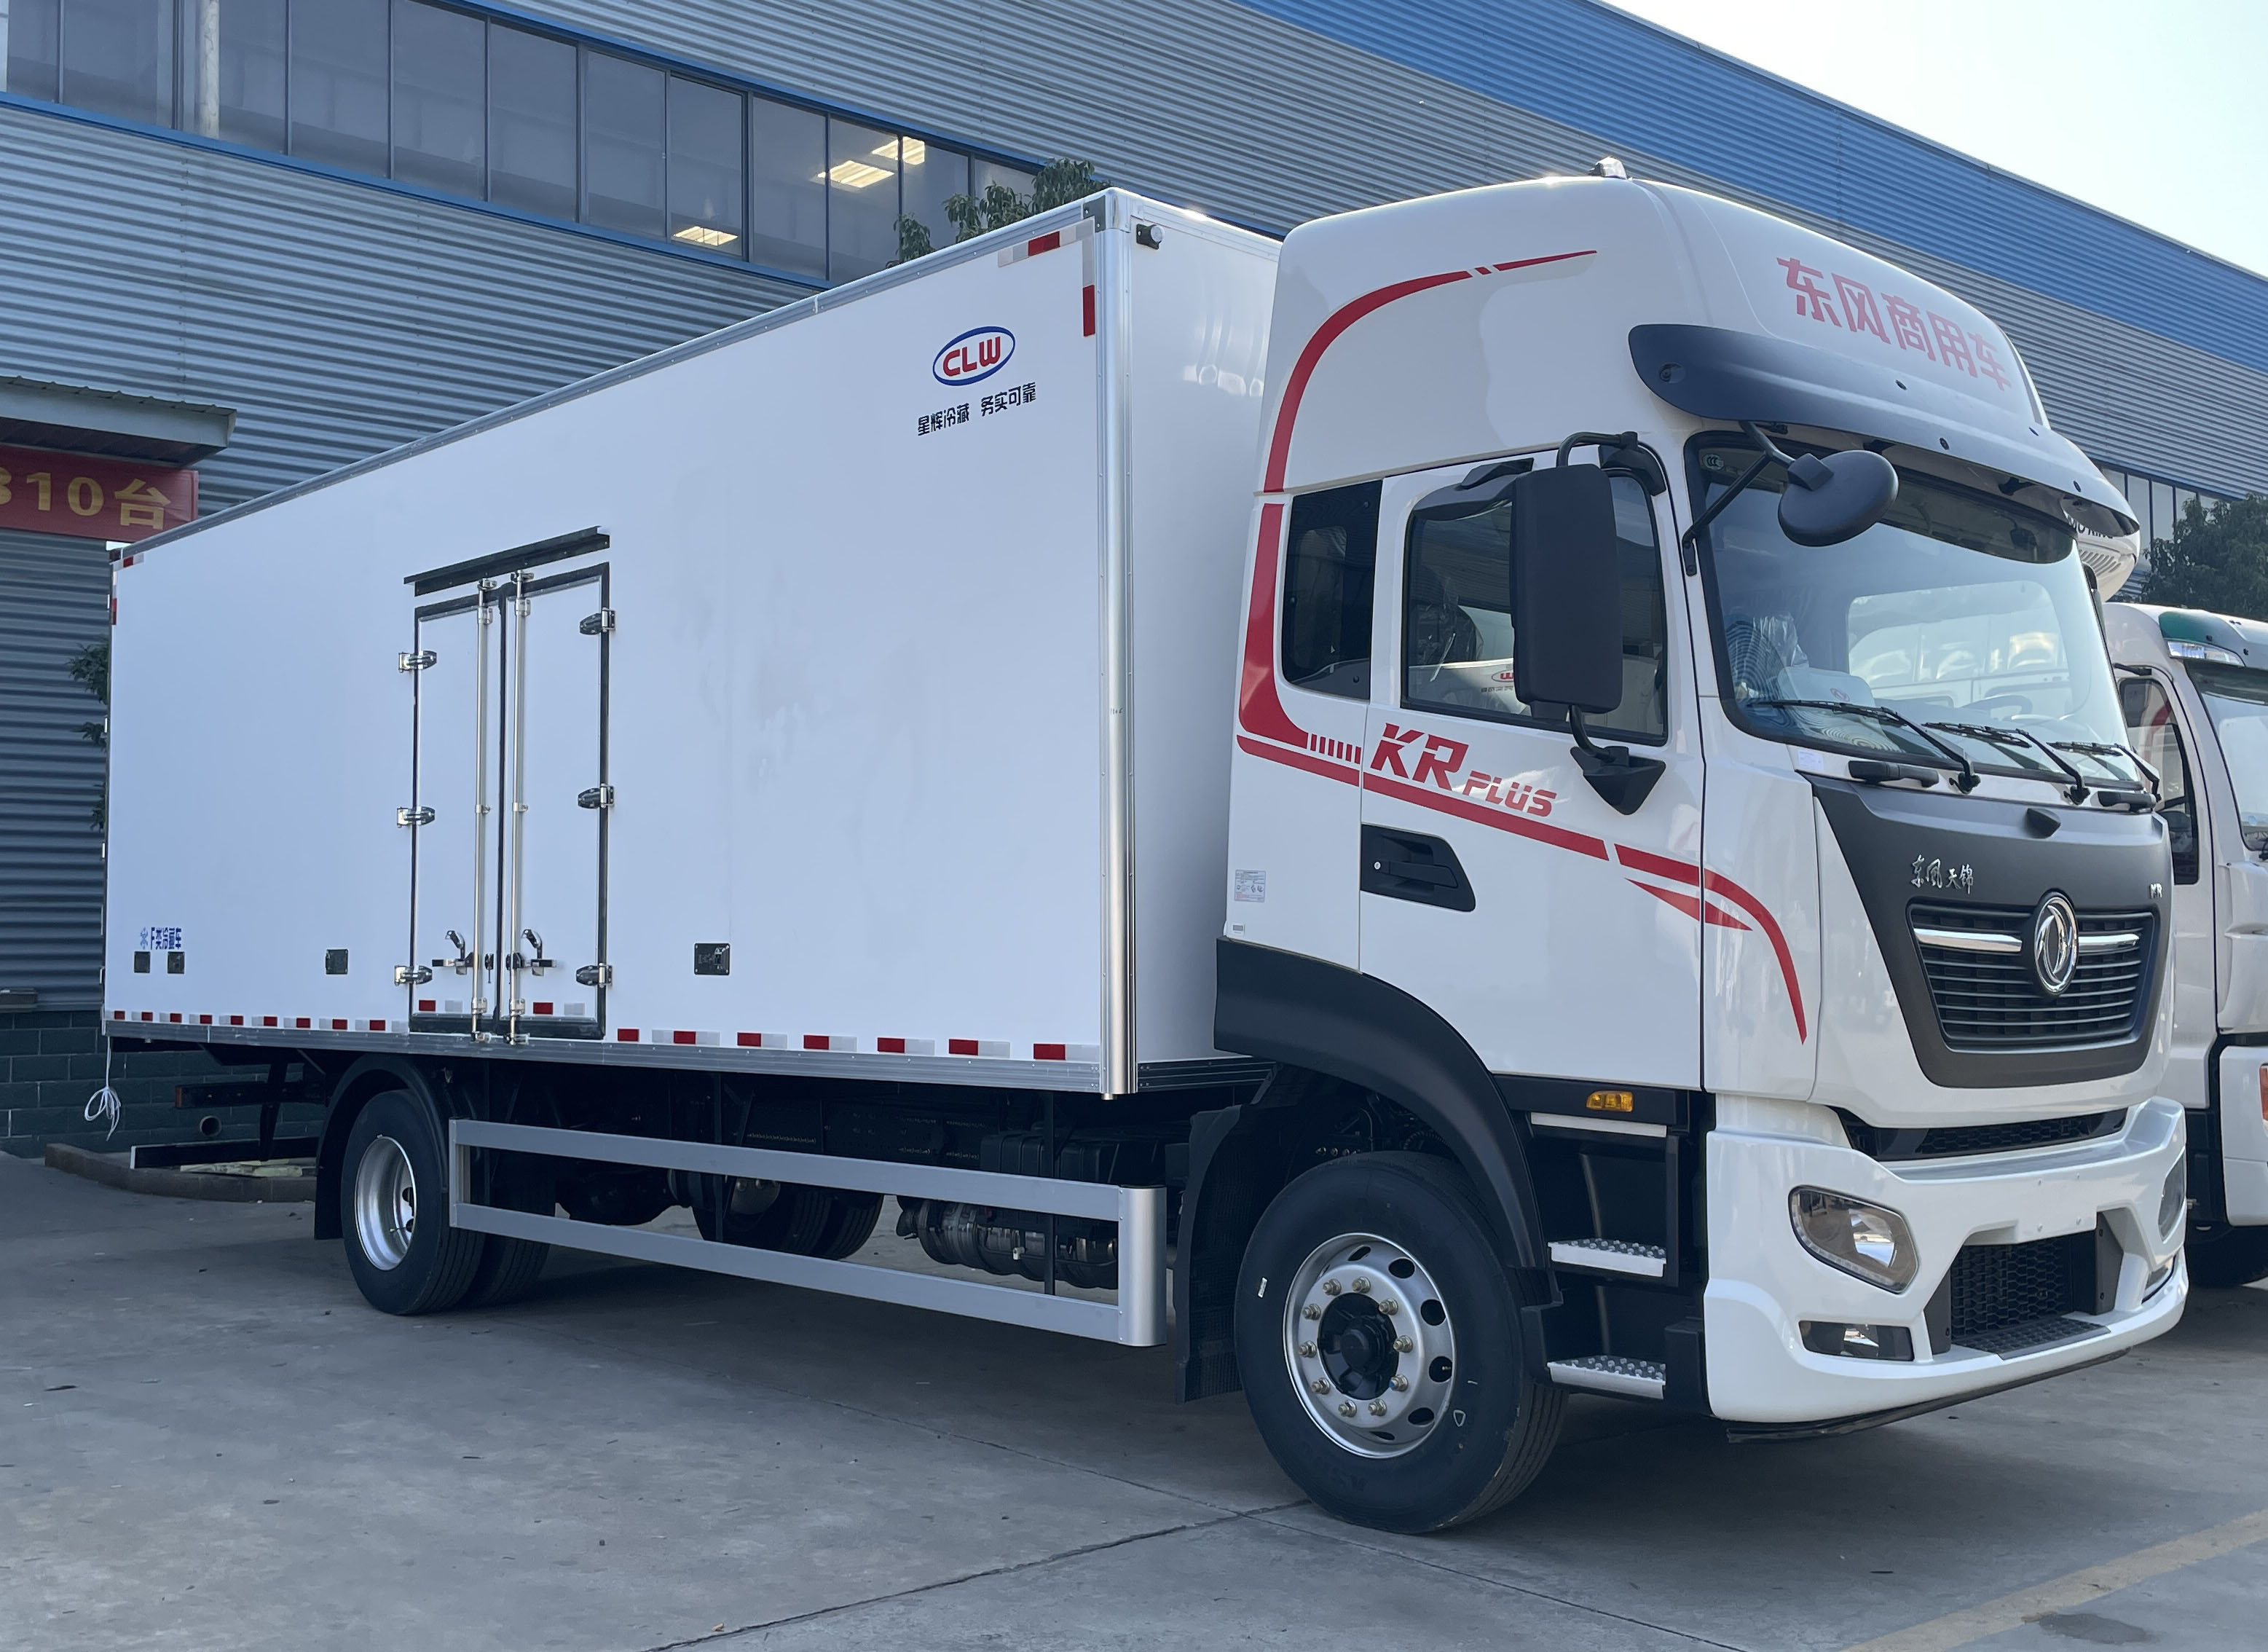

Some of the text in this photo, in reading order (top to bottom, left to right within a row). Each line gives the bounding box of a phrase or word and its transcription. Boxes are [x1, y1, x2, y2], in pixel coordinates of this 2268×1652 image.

[942, 336, 1001, 377] CLW
[1776, 257, 2011, 391] 东风商用车
[917, 382, 1036, 436] 星辉冷藏 务实可靠
[1370, 722, 1557, 817] KR PLUS
